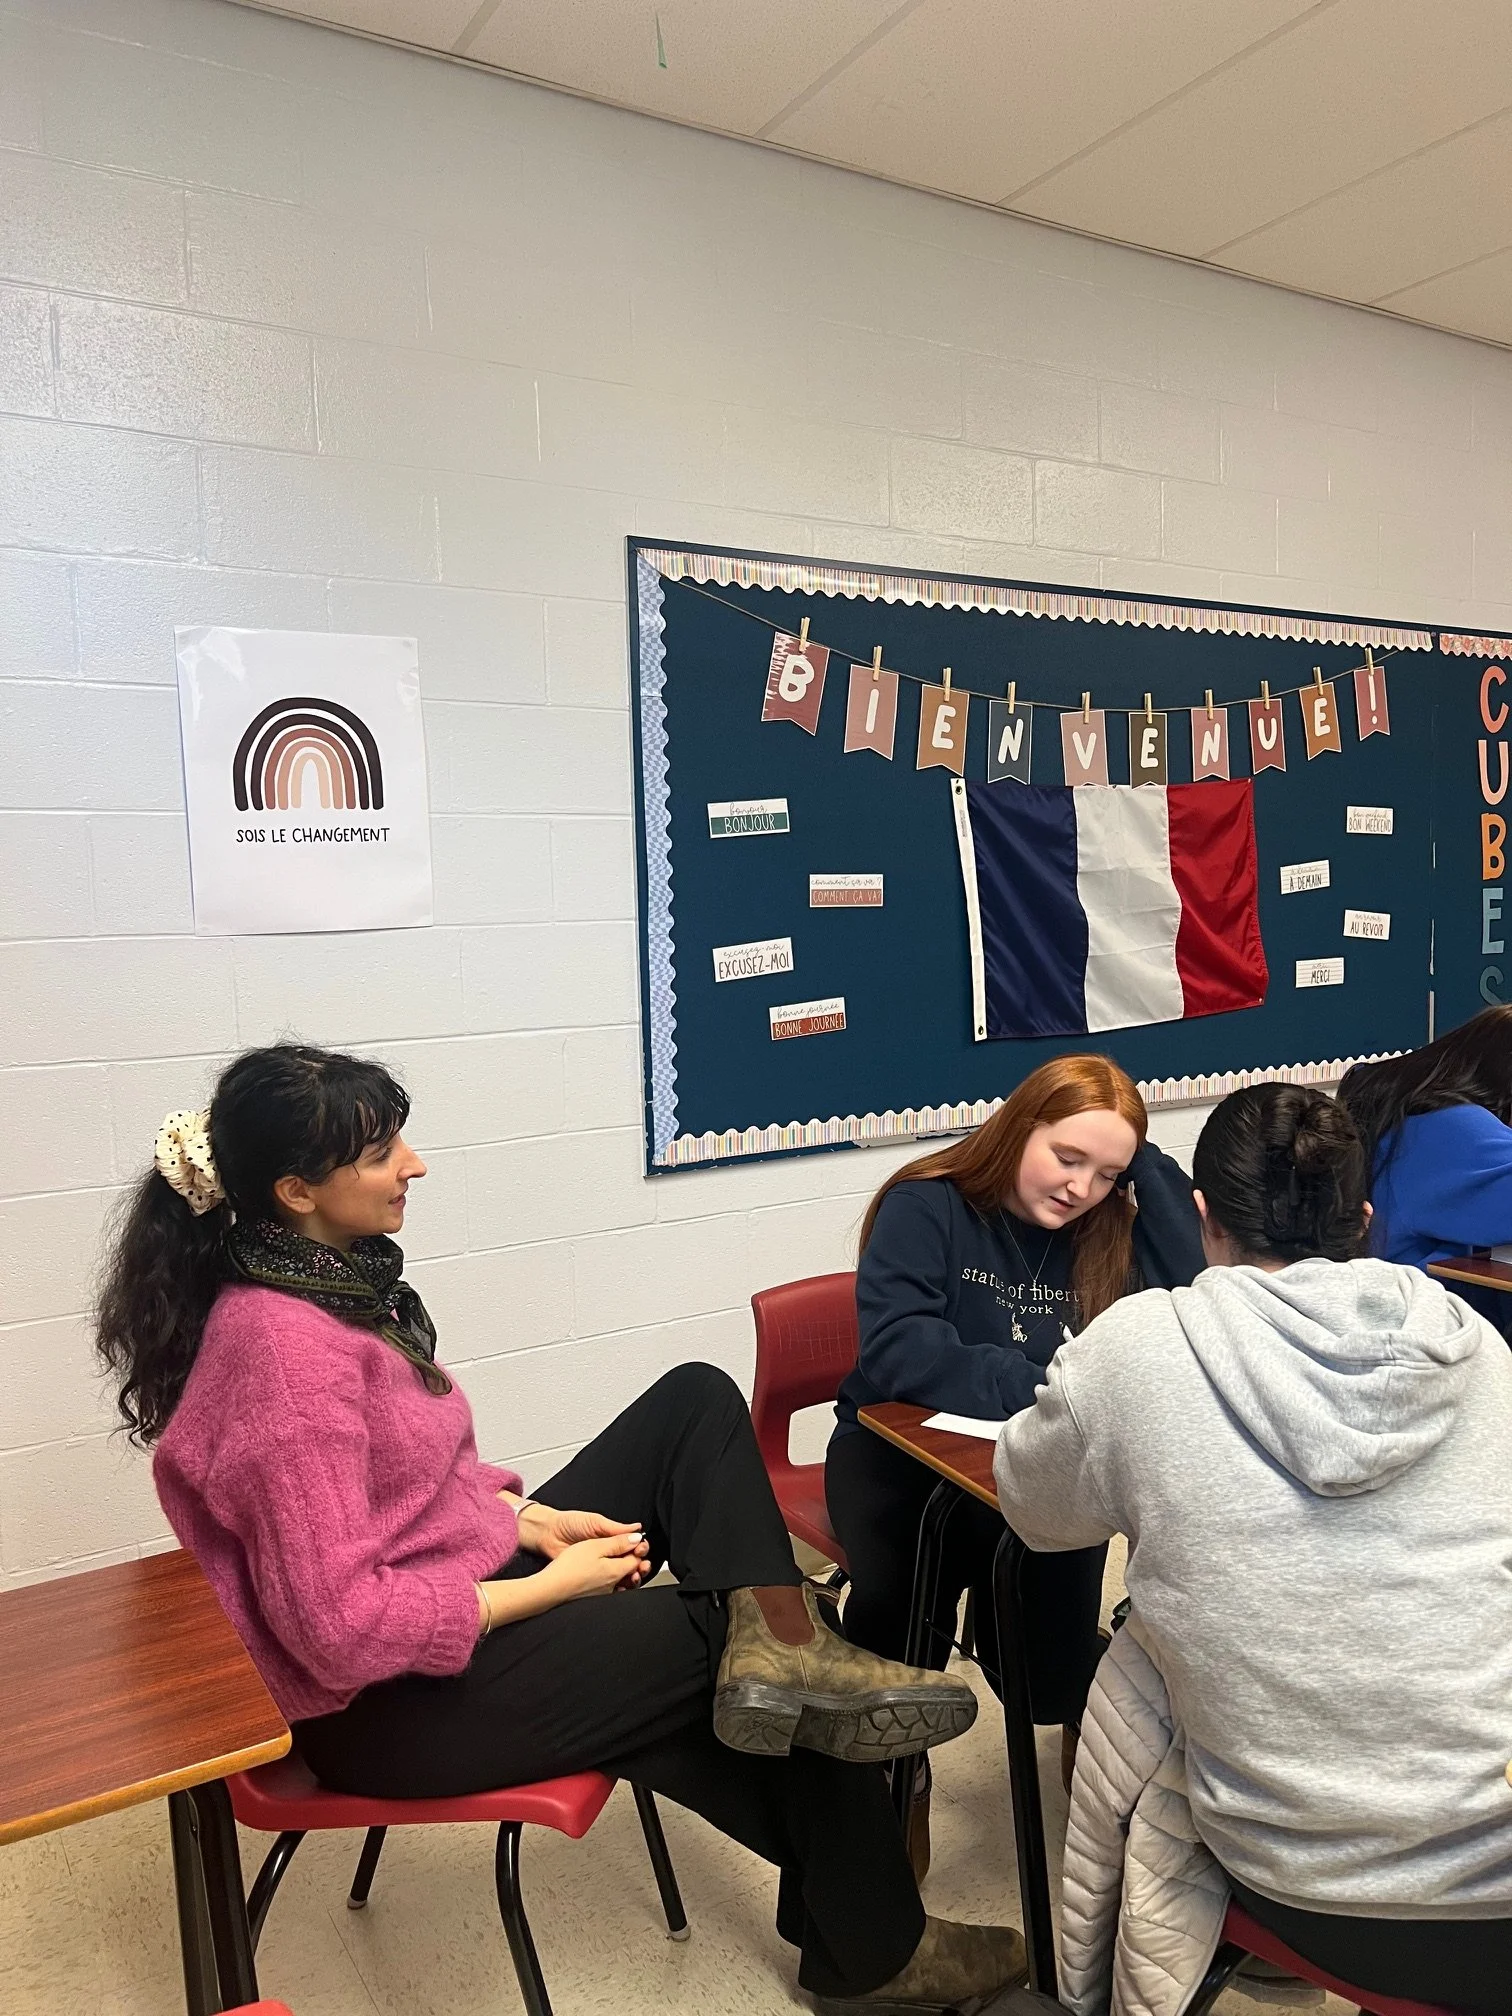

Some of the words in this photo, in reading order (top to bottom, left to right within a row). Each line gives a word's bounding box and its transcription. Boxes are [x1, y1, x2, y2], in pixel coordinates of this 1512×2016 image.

[779, 654, 1377, 769] BIENVENUE!
[724, 814, 776, 834] BONJOUR
[1349, 816, 1362, 831] BON
[1365, 818, 1392, 833] WEEKEND
[236, 829, 266, 843] SOIS
[271, 829, 287, 843] LE
[292, 827, 390, 843] CHANGEMENT
[1478, 665, 1509, 1006] CUBES
[1297, 873, 1322, 890] DEMAIN
[812, 890, 849, 903] COMMENT
[1350, 921, 1360, 935] AU
[1362, 922, 1384, 937] REVOIR
[718, 951, 790, 980] EXCUSEZ-MOI
[1311, 969, 1331, 985] MERCI
[775, 1019, 802, 1038] BONNE
[1008, 1283, 1026, 1300] of
[1031, 1284, 1081, 1303] libert
[995, 1296, 1015, 1310] new
[1019, 1304, 1054, 1315] york
